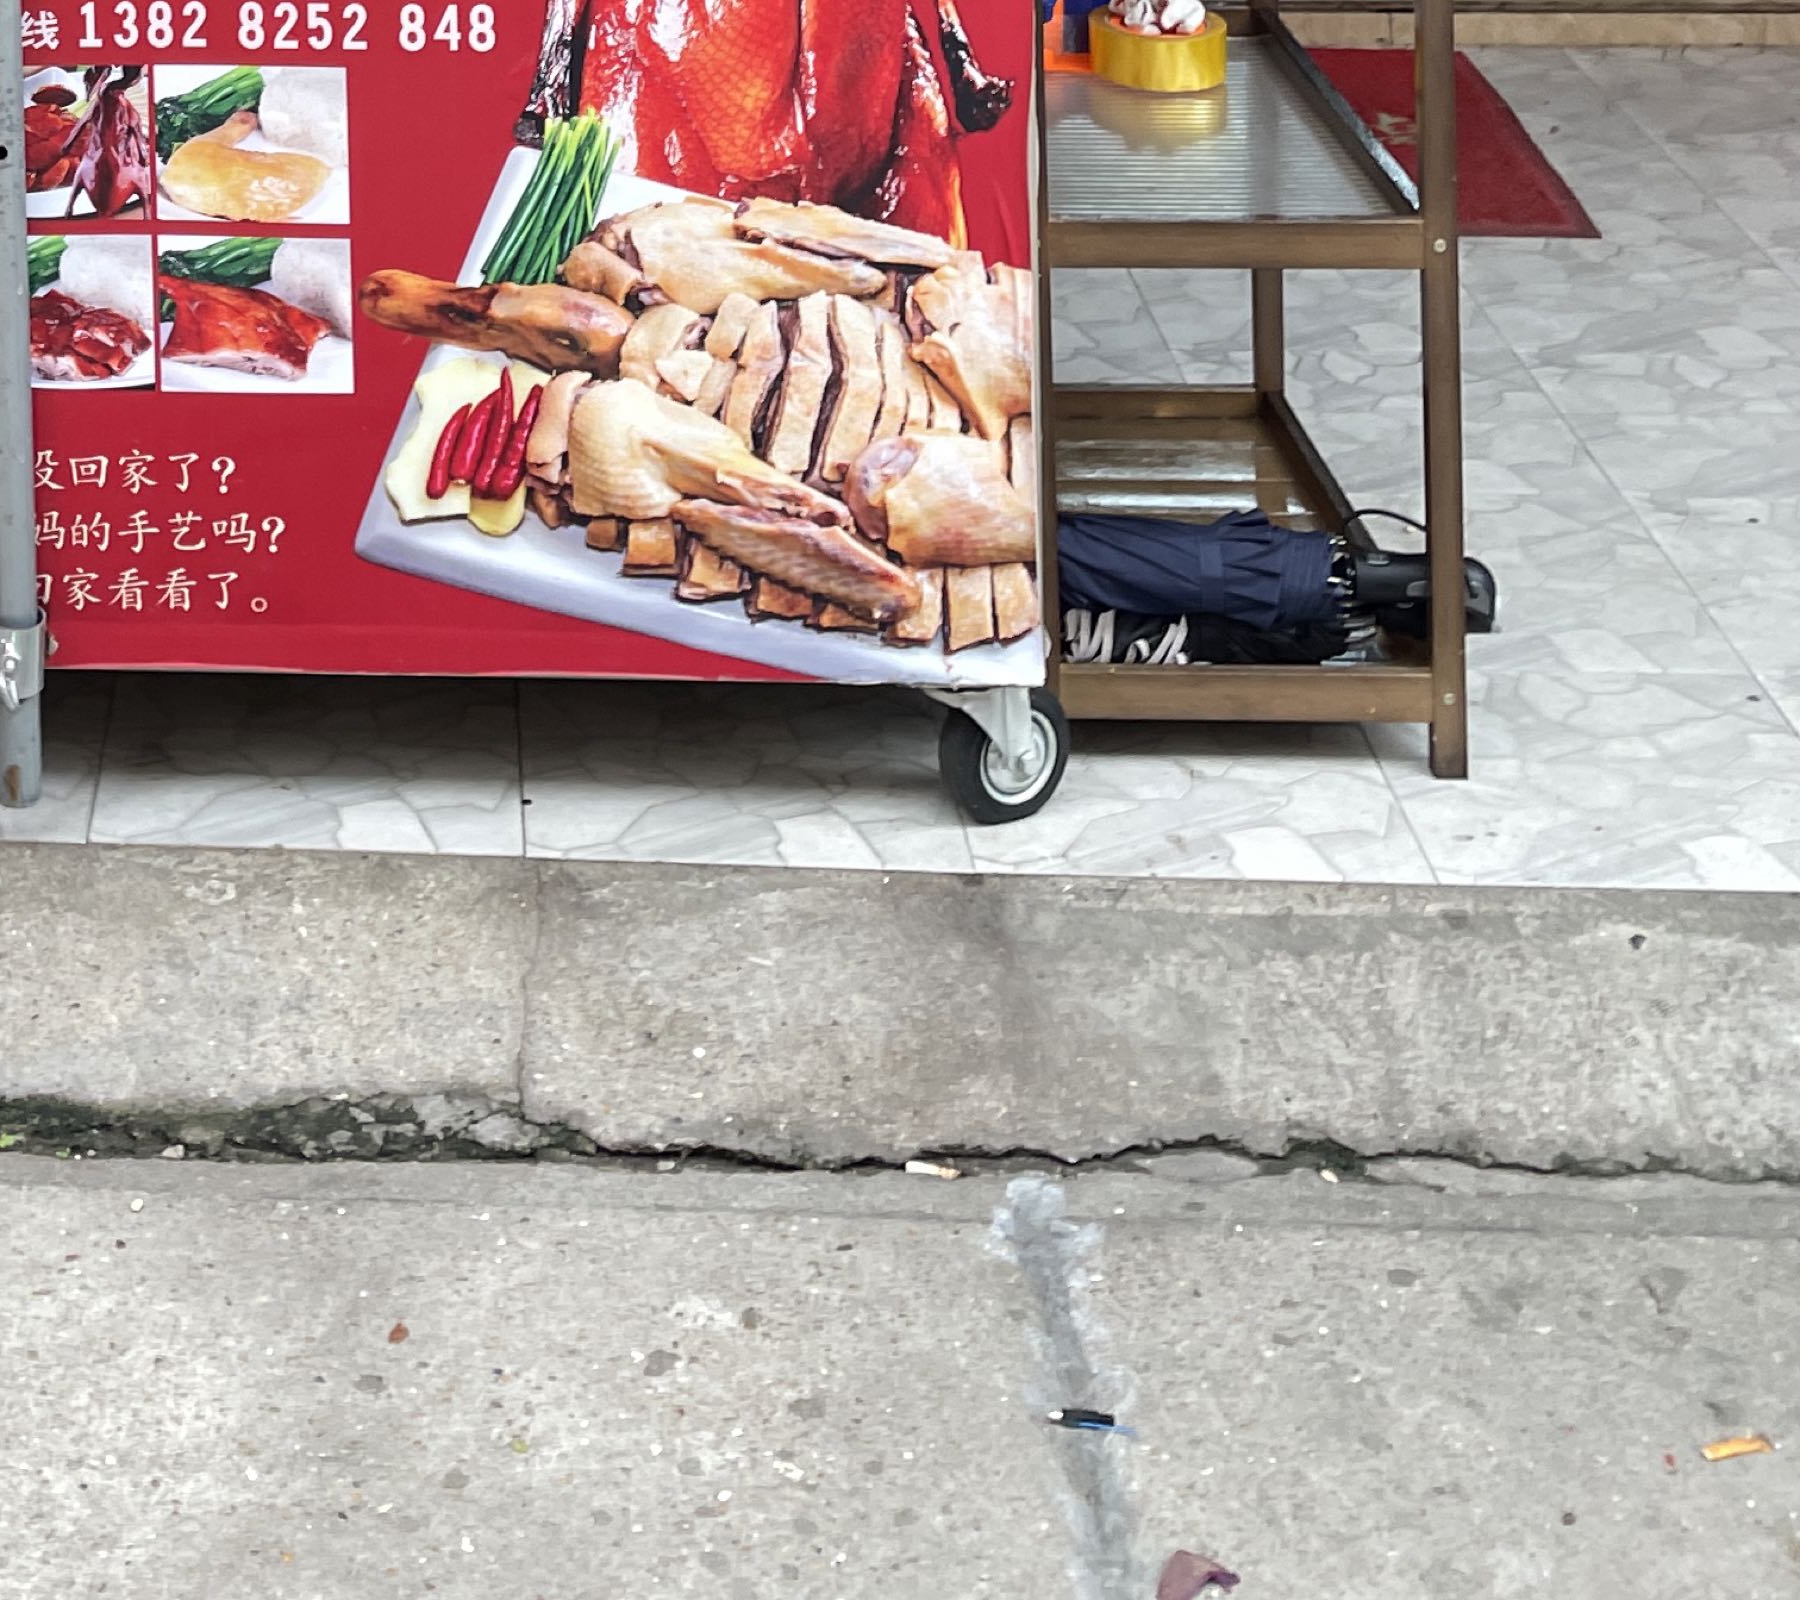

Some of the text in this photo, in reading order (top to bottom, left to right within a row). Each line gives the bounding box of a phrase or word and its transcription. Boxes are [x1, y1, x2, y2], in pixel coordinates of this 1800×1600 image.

[78, 0, 208, 49] 1382
[237, 1, 369, 51] 8252
[398, 3, 497, 53] 848
